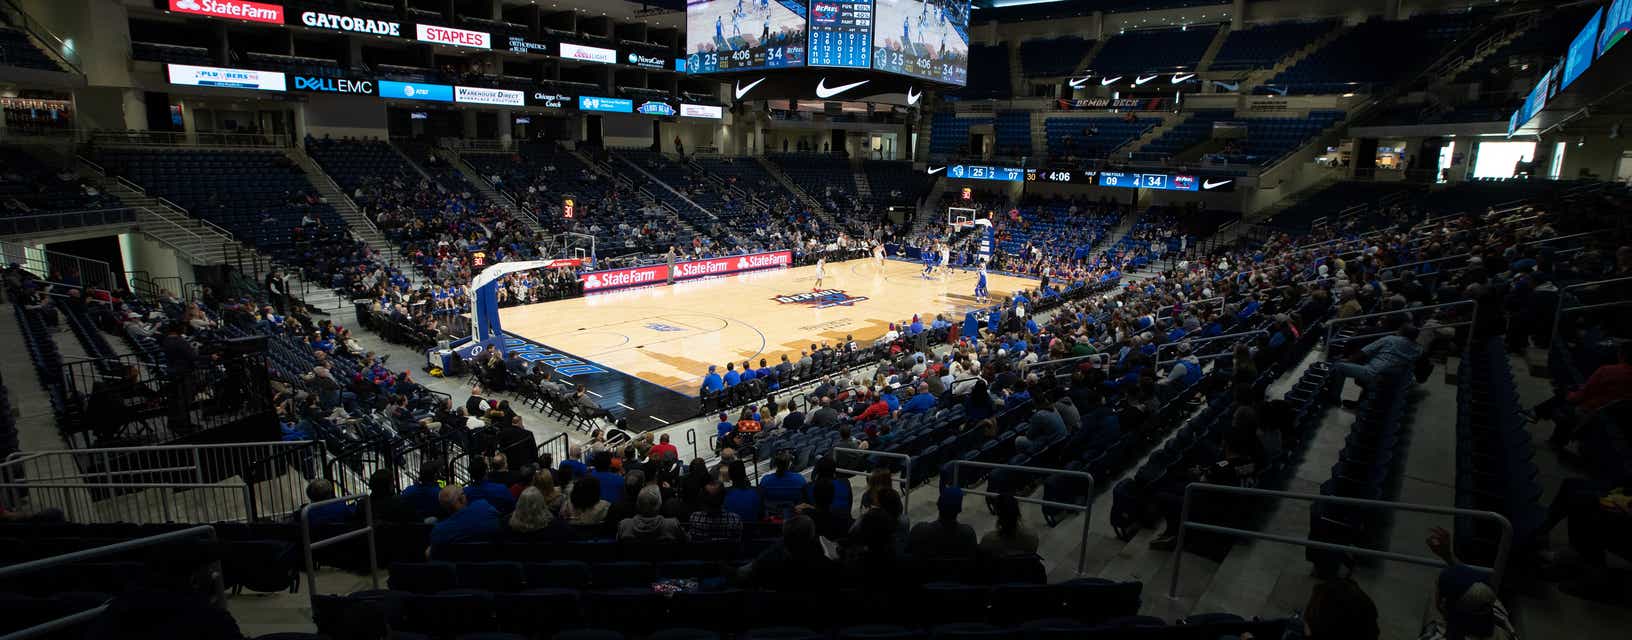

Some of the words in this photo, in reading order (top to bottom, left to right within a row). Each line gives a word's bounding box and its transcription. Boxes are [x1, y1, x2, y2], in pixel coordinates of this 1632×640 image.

[302, 12, 400, 36] GATORADE
[427, 28, 482, 46] STAPLES
[704, 53, 717, 65] 25
[732, 50, 750, 60] 4:06
[768, 47, 782, 60] 34
[892, 52, 904, 66] 25
[916, 58, 931, 69] 4:06
[942, 64, 953, 76] 34
[973, 168, 983, 177] 25
[1008, 172, 1018, 180] 07
[1050, 171, 1070, 182] 4:06
[1088, 176, 1092, 184] 1
[1106, 176, 1117, 185] 09
[1133, 178, 1139, 186] 4
[1148, 176, 1161, 186] 34
[564, 206, 572, 218] 30
